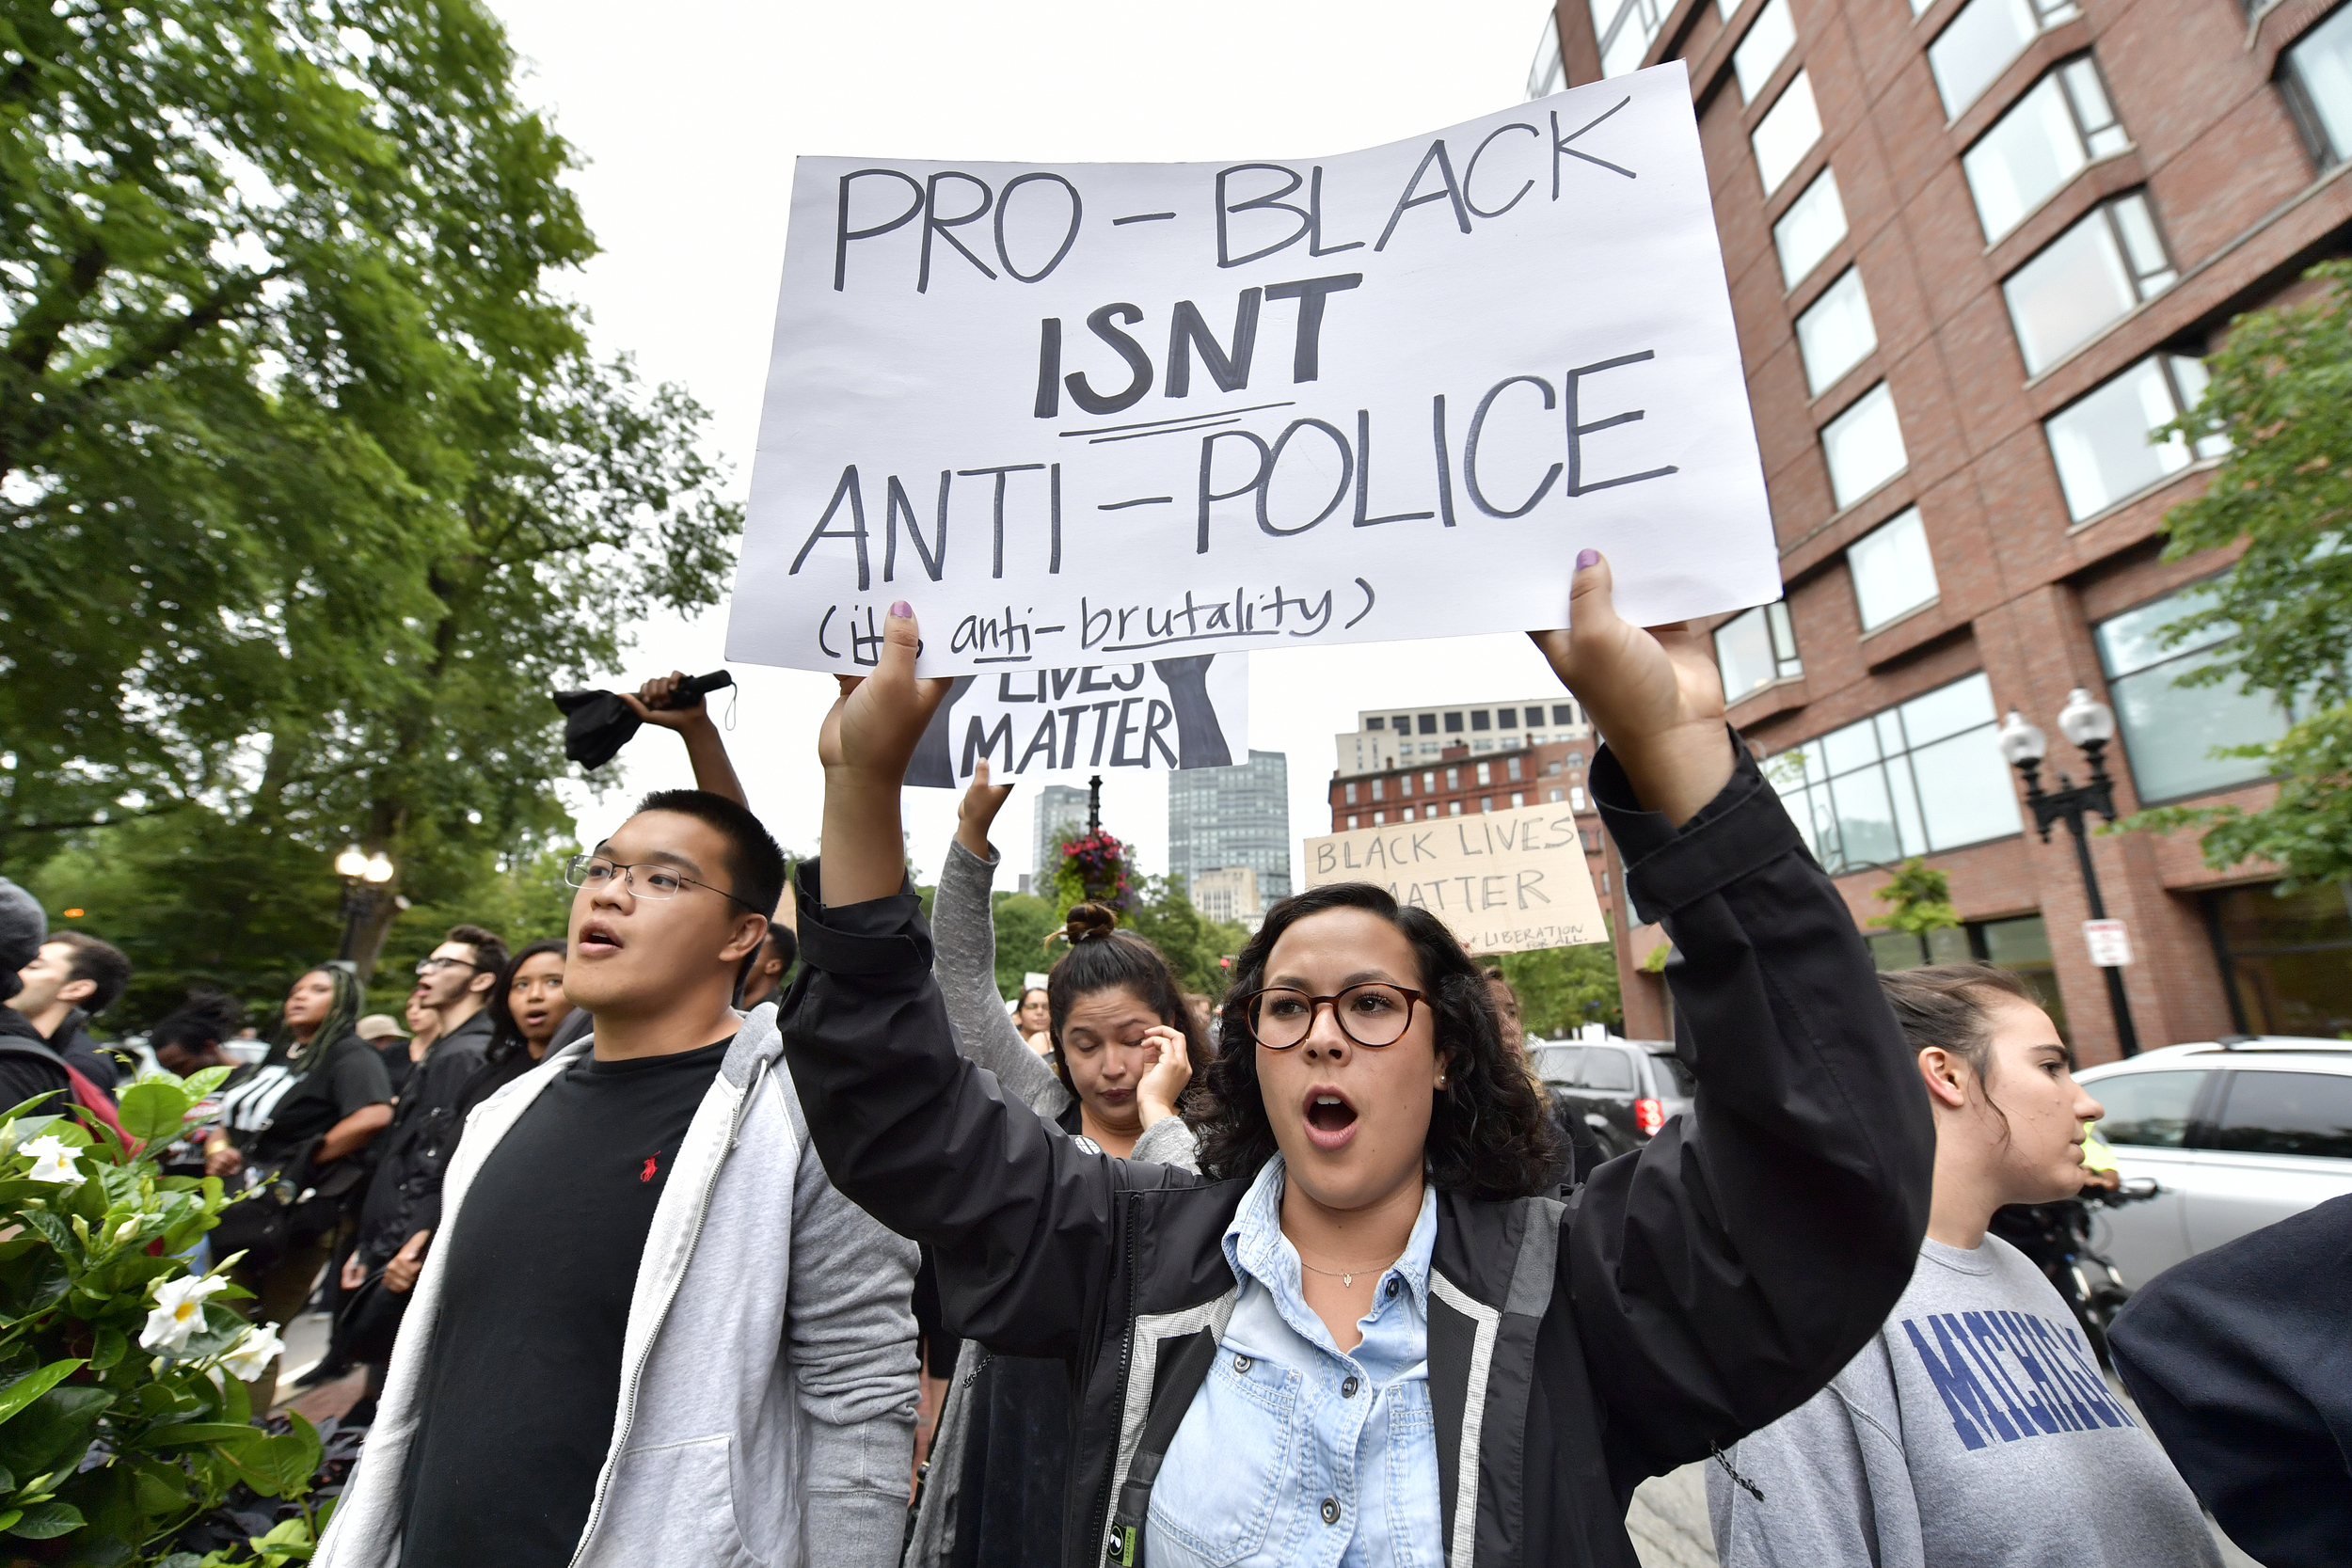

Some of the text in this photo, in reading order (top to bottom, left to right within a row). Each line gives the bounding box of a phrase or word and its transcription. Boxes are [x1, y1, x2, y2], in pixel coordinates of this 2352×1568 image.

[1034, 273, 1363, 419] ISNT
[960, 696, 1179, 779] MATTER
[1317, 816, 1575, 874] BLACK LIVES
[1485, 924, 1584, 947] LIBERATION
[1526, 940, 1549, 950] FOR
